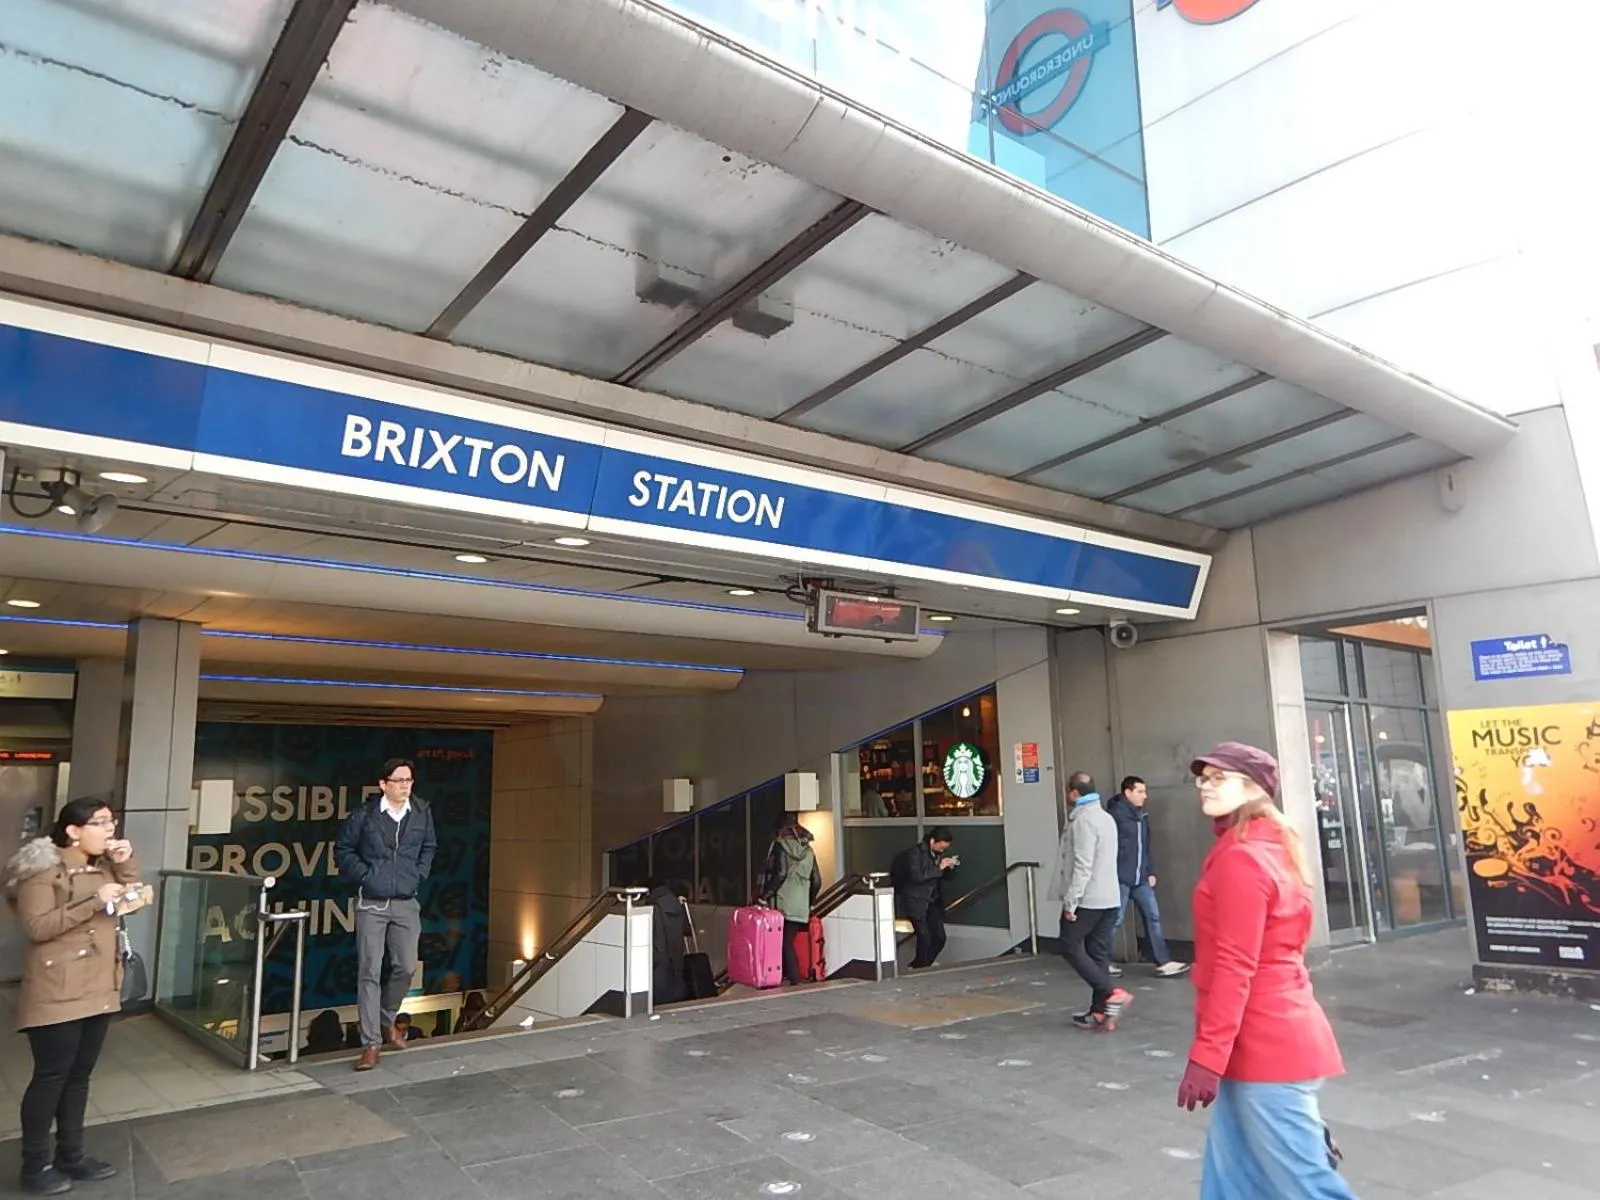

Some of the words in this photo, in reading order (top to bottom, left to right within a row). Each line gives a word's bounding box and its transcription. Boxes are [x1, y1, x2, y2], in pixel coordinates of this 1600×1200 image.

[341, 414, 565, 492] BRIXTON
[628, 470, 785, 529] STATION
[1472, 725, 1562, 748] MUSIC
